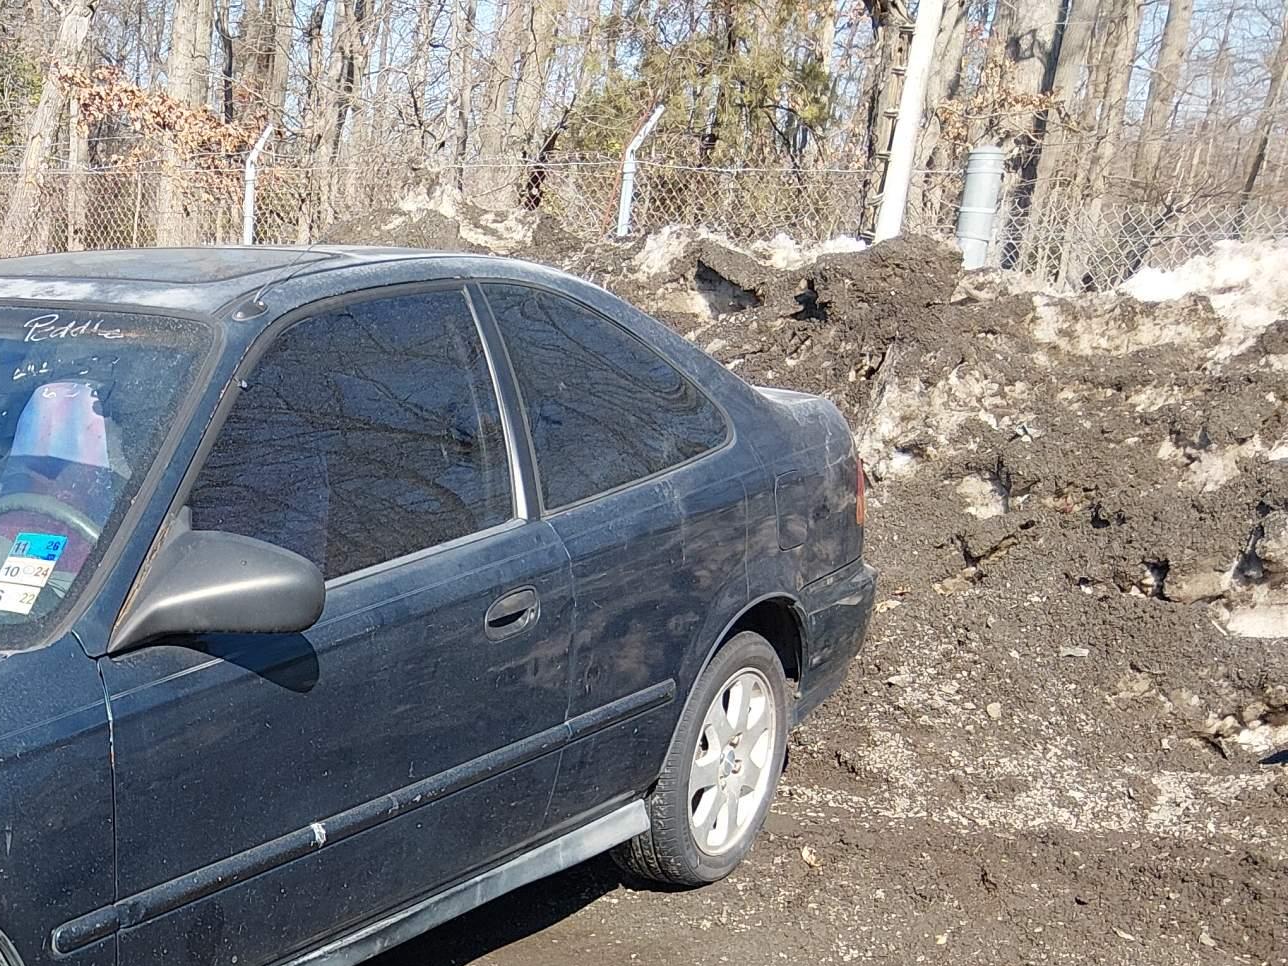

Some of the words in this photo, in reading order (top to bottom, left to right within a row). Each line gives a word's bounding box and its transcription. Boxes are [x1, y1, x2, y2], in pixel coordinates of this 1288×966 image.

[14, 541, 28, 553] 11
[46, 541, 61, 551] 26
[4, 566, 20, 577] 10
[33, 566, 50, 577] 24
